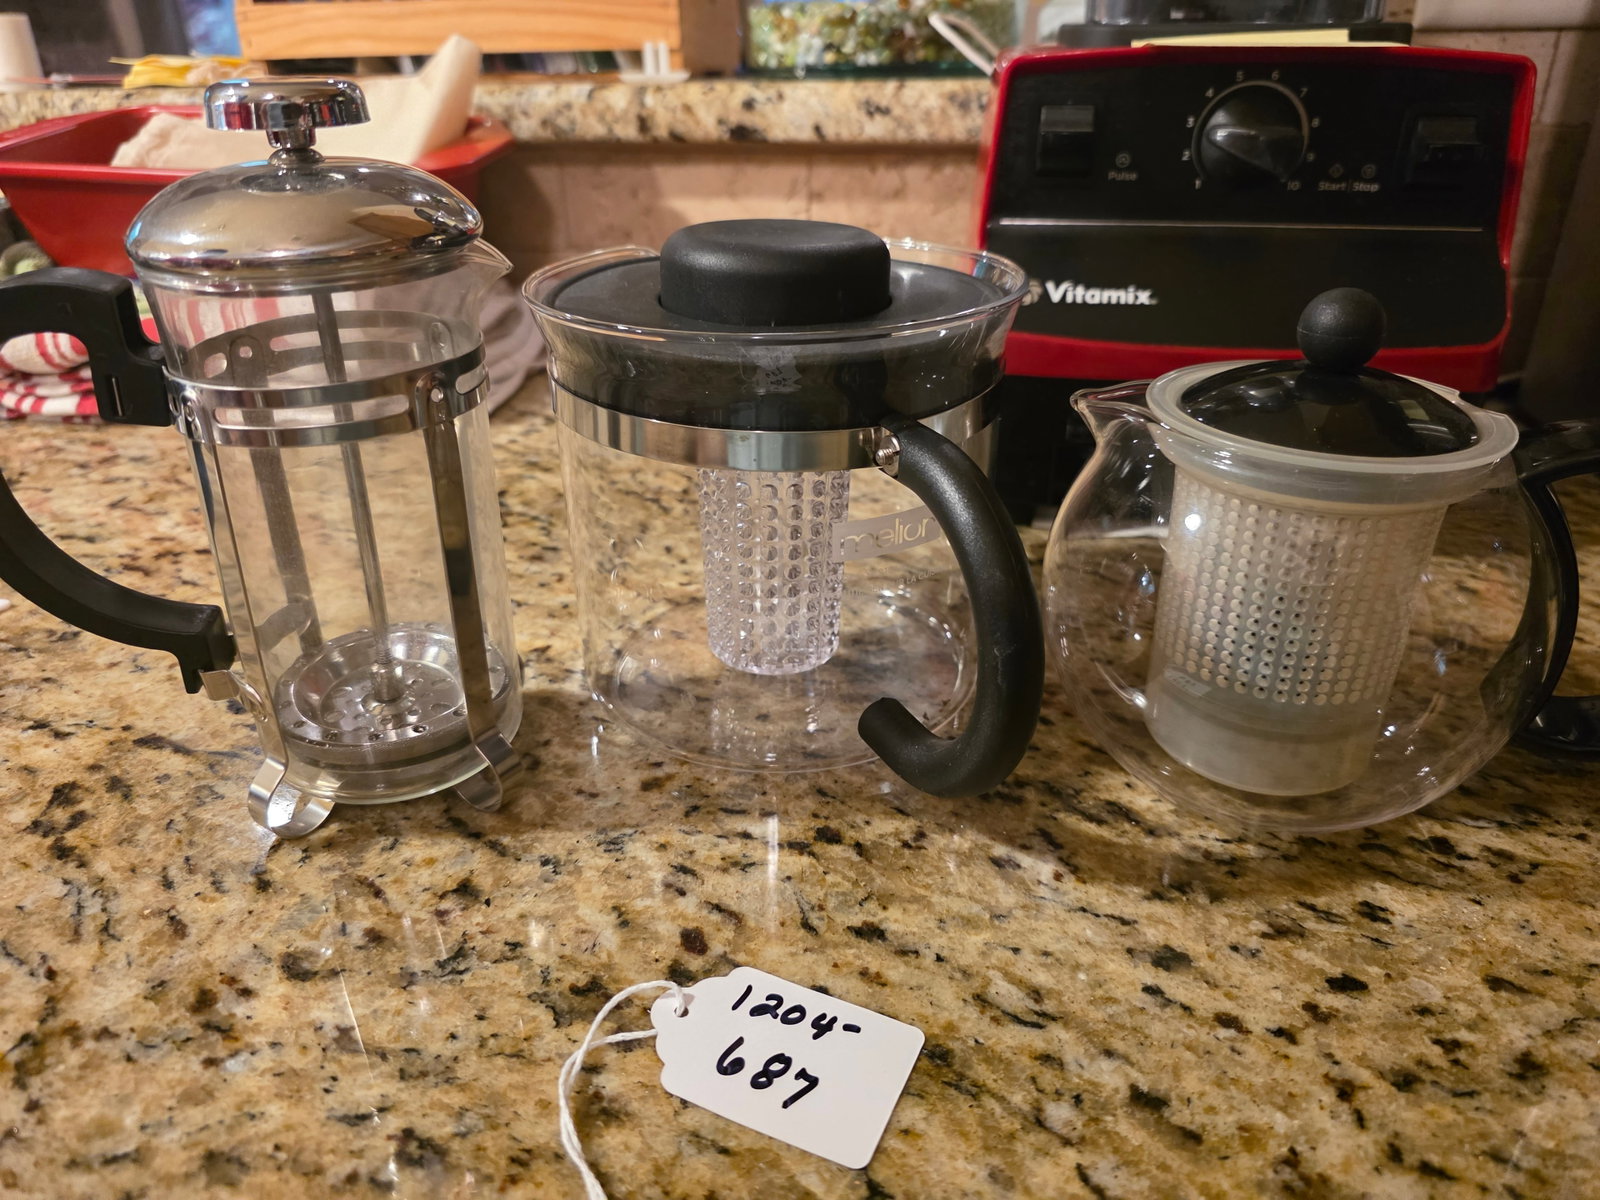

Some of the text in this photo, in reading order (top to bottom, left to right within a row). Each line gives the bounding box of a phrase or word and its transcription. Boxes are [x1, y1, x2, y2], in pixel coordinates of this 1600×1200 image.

[1236, 71, 1244, 81] 5
[1271, 70, 1280, 81] 6
[1205, 88, 1215, 98] 4
[1300, 88, 1309, 98] 7
[1186, 118, 1195, 128] 3
[1311, 118, 1320, 128] 8
[1181, 151, 1191, 161] 2
[1306, 152, 1315, 162] 9
[1108, 171, 1138, 181] Pulse
[1194, 180, 1202, 190] 1
[1287, 181, 1301, 191] 10
[1318, 181, 1380, 193] Start Stop
[1045, 280, 1152, 305] Vitamix
[715, 1036, 820, 1110] 687
